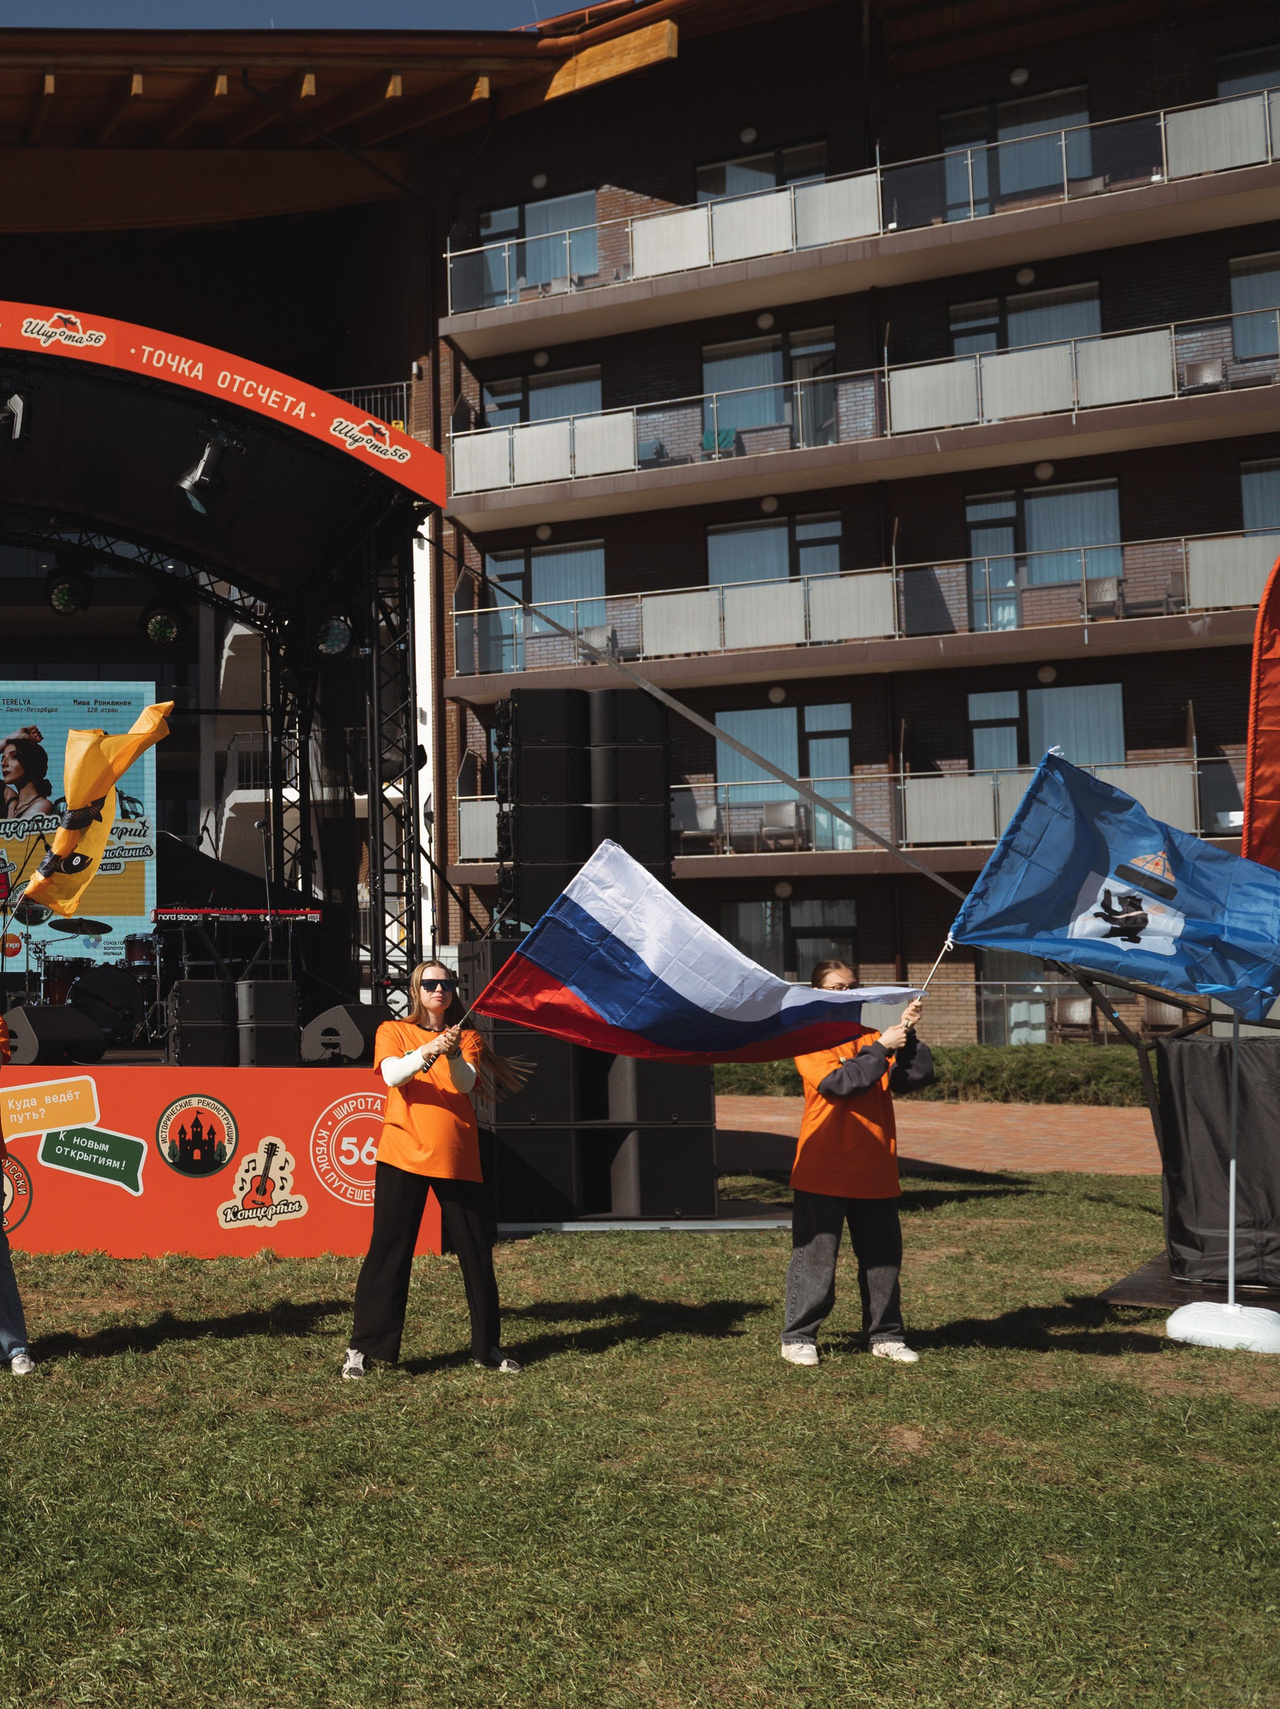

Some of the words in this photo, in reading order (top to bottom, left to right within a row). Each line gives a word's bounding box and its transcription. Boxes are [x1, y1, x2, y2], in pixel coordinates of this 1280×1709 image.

[141, 345, 204, 381] ТОЧКА
[217, 371, 306, 420] ОТСЧЕТА
[7, 1097, 37, 1112] Куда
[44, 1089, 80, 1105] ведёт
[332, 1098, 381, 1120] ШИРОТА
[9, 1107, 46, 1124] путь?
[160, 1099, 193, 1144] ИСТОРИЧЕСКИЕ
[197, 1099, 234, 1145] РЕКОНСТРУКЦИИ
[72, 1136, 110, 1152] новым
[316, 1129, 331, 1172] КУБОК
[339, 1136, 378, 1166] 56
[55, 1145, 126, 1171] открытиям!
[2, 1159, 27, 1195] УССКИ
[223, 1200, 302, 1222] Концерты
